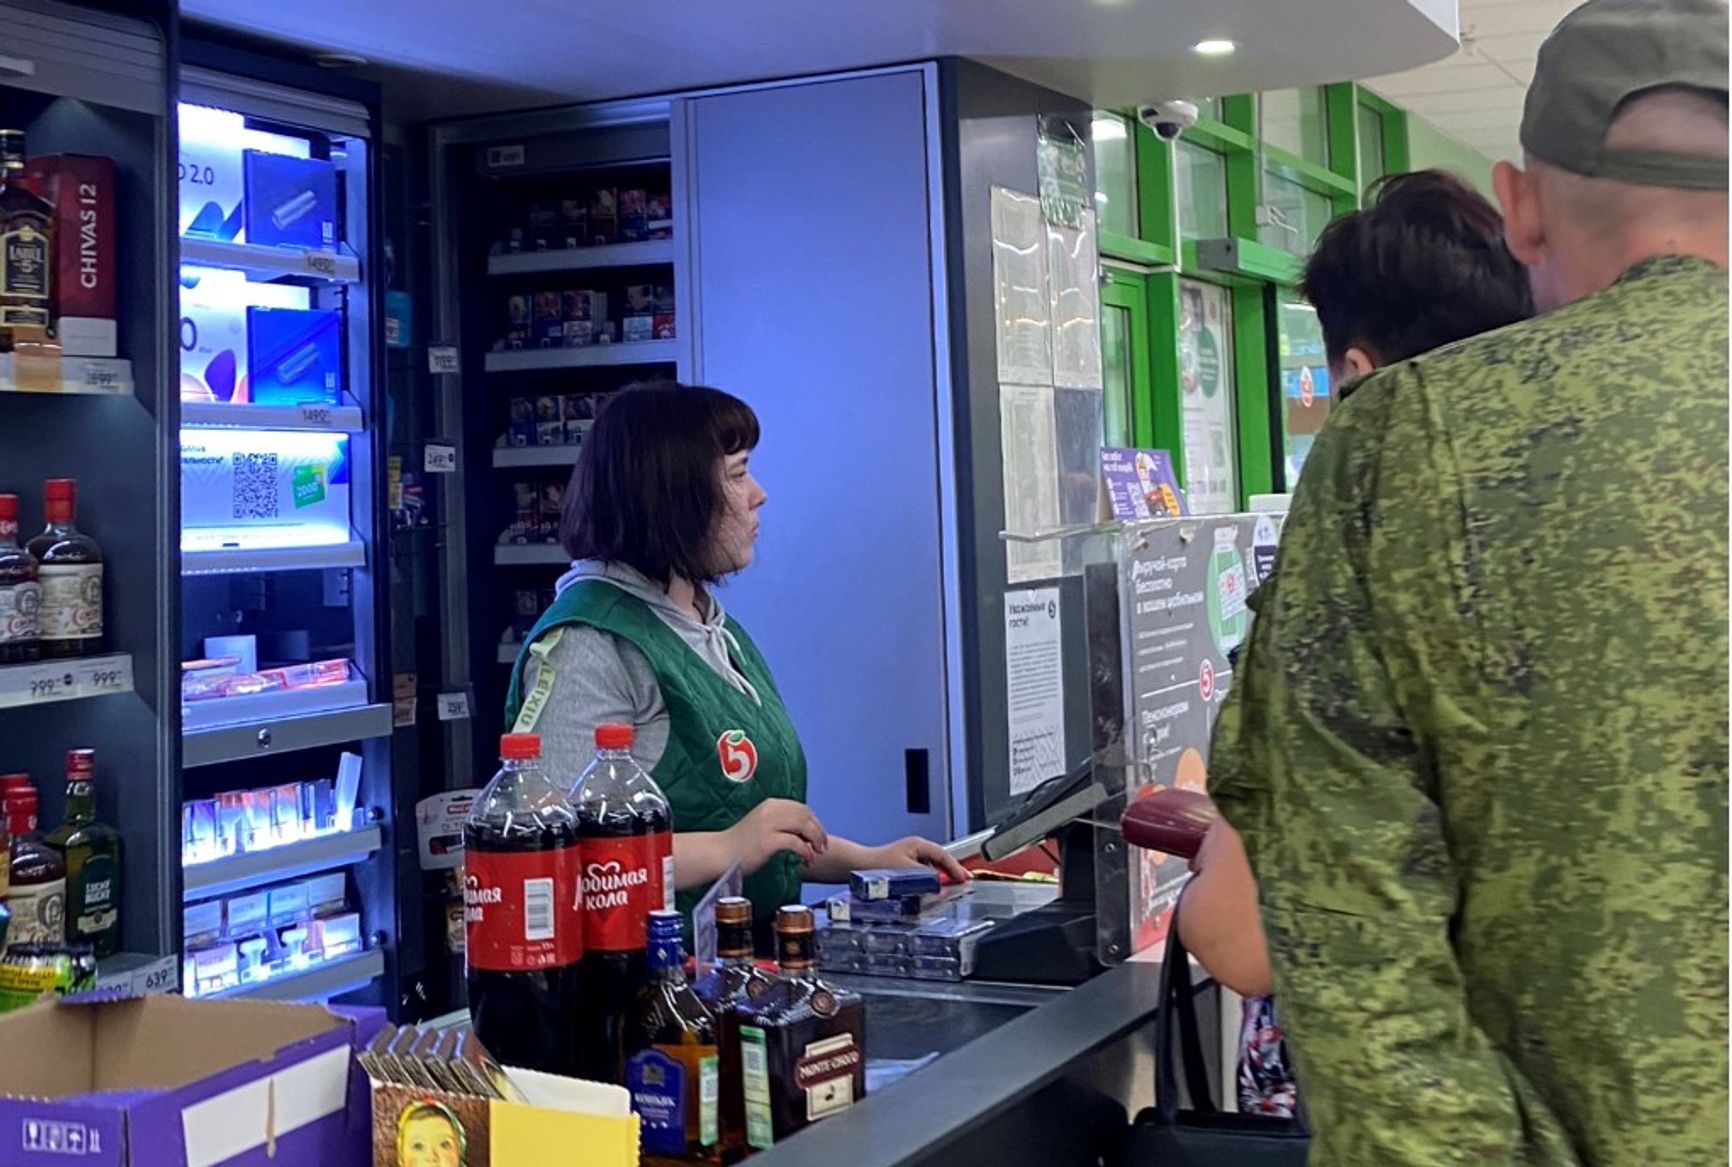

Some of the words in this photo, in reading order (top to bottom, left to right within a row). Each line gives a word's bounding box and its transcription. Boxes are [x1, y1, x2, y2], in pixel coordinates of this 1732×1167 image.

[189, 164, 214, 185] 2.0
[80, 183, 97, 205] 12
[9, 245, 42, 262] LABEL
[80, 210, 98, 289] CHIVAS
[93, 671, 117, 687] 999
[585, 889, 628, 910] кола
[145, 968, 169, 989] 639
